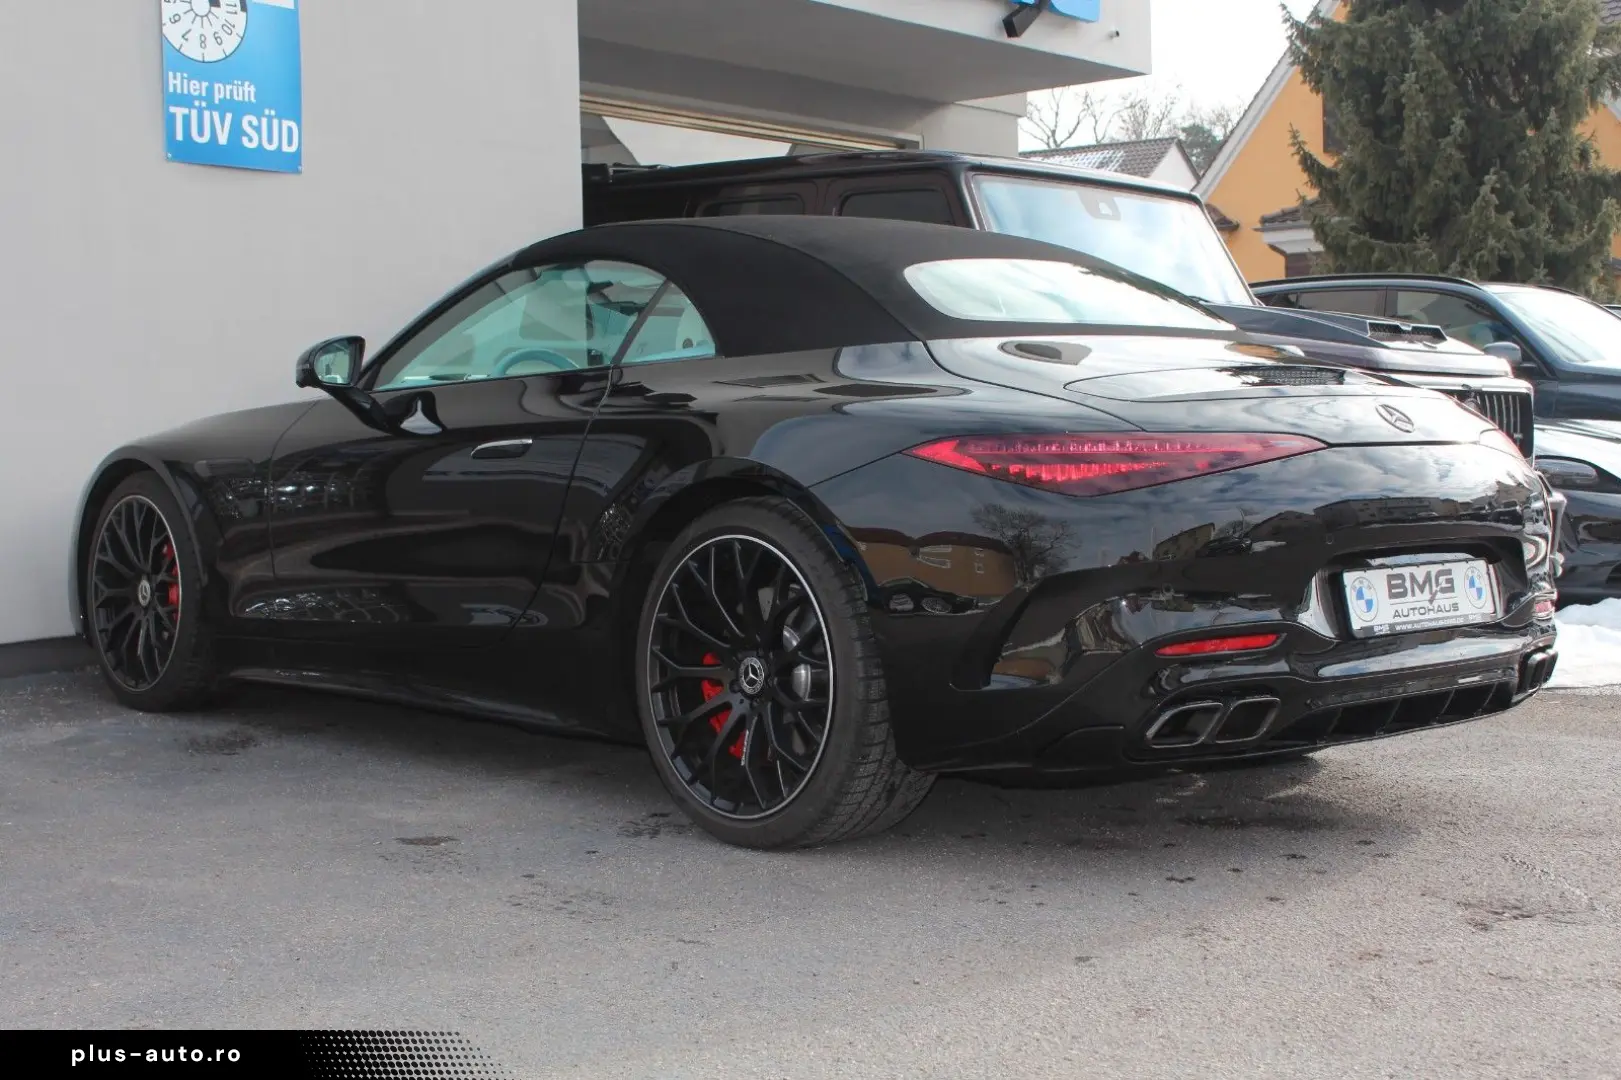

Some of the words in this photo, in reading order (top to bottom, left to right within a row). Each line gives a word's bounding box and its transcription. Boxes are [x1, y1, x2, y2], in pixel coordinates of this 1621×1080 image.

[226, 3, 238, 15] 11
[181, 28, 192, 41] 7
[221, 18, 236, 36] 10
[199, 33, 207, 49] 8
[213, 31, 223, 46] 9
[168, 71, 209, 96] Hier
[213, 80, 256, 104] prüft
[169, 100, 233, 146] TÜV
[241, 108, 299, 153] SÜD
[1386, 568, 1455, 601] BMG
[1392, 602, 1460, 619] AUTOHAUS
